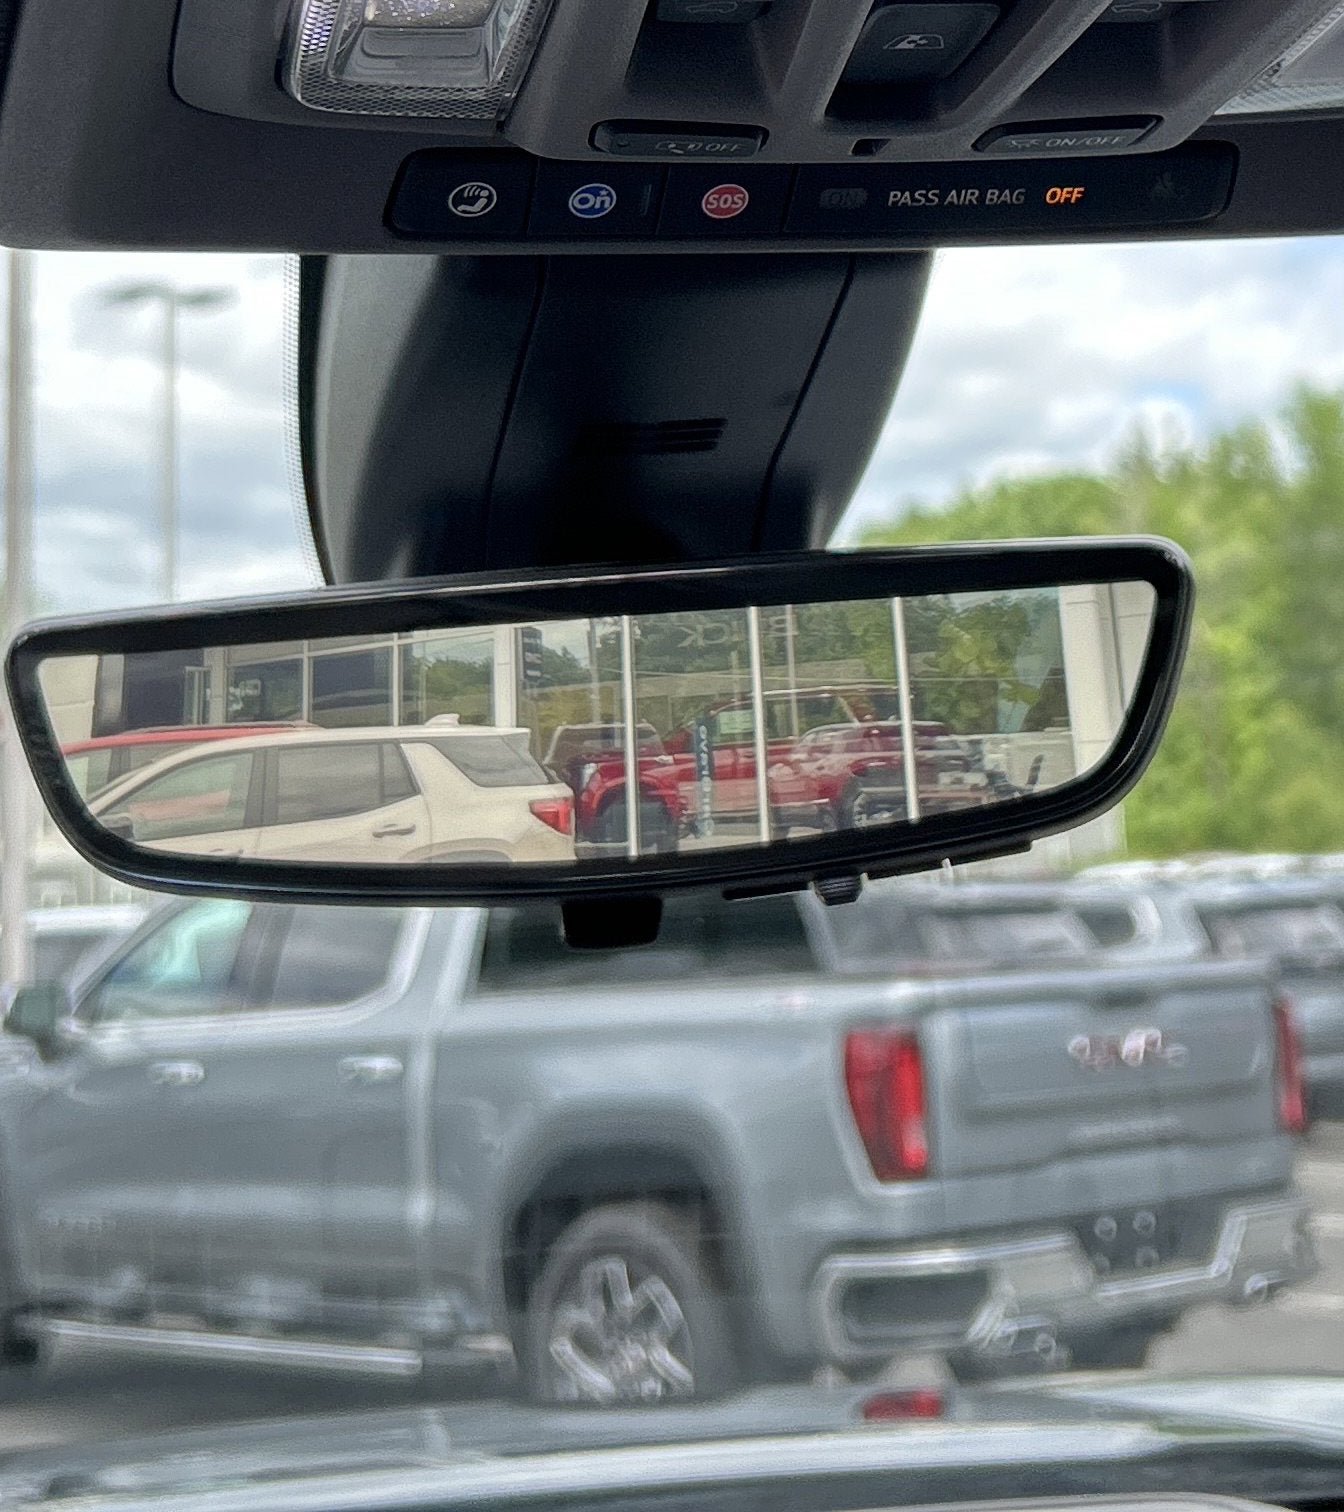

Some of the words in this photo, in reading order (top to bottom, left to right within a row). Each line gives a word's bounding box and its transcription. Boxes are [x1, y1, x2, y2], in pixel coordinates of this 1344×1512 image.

[1045, 135, 1126, 148] ON/OFF
[706, 193, 744, 209] SOS
[887, 189, 940, 207] PASS
[943, 188, 980, 206] AIR
[985, 187, 1026, 205] BAG
[1044, 186, 1086, 205] OFF
